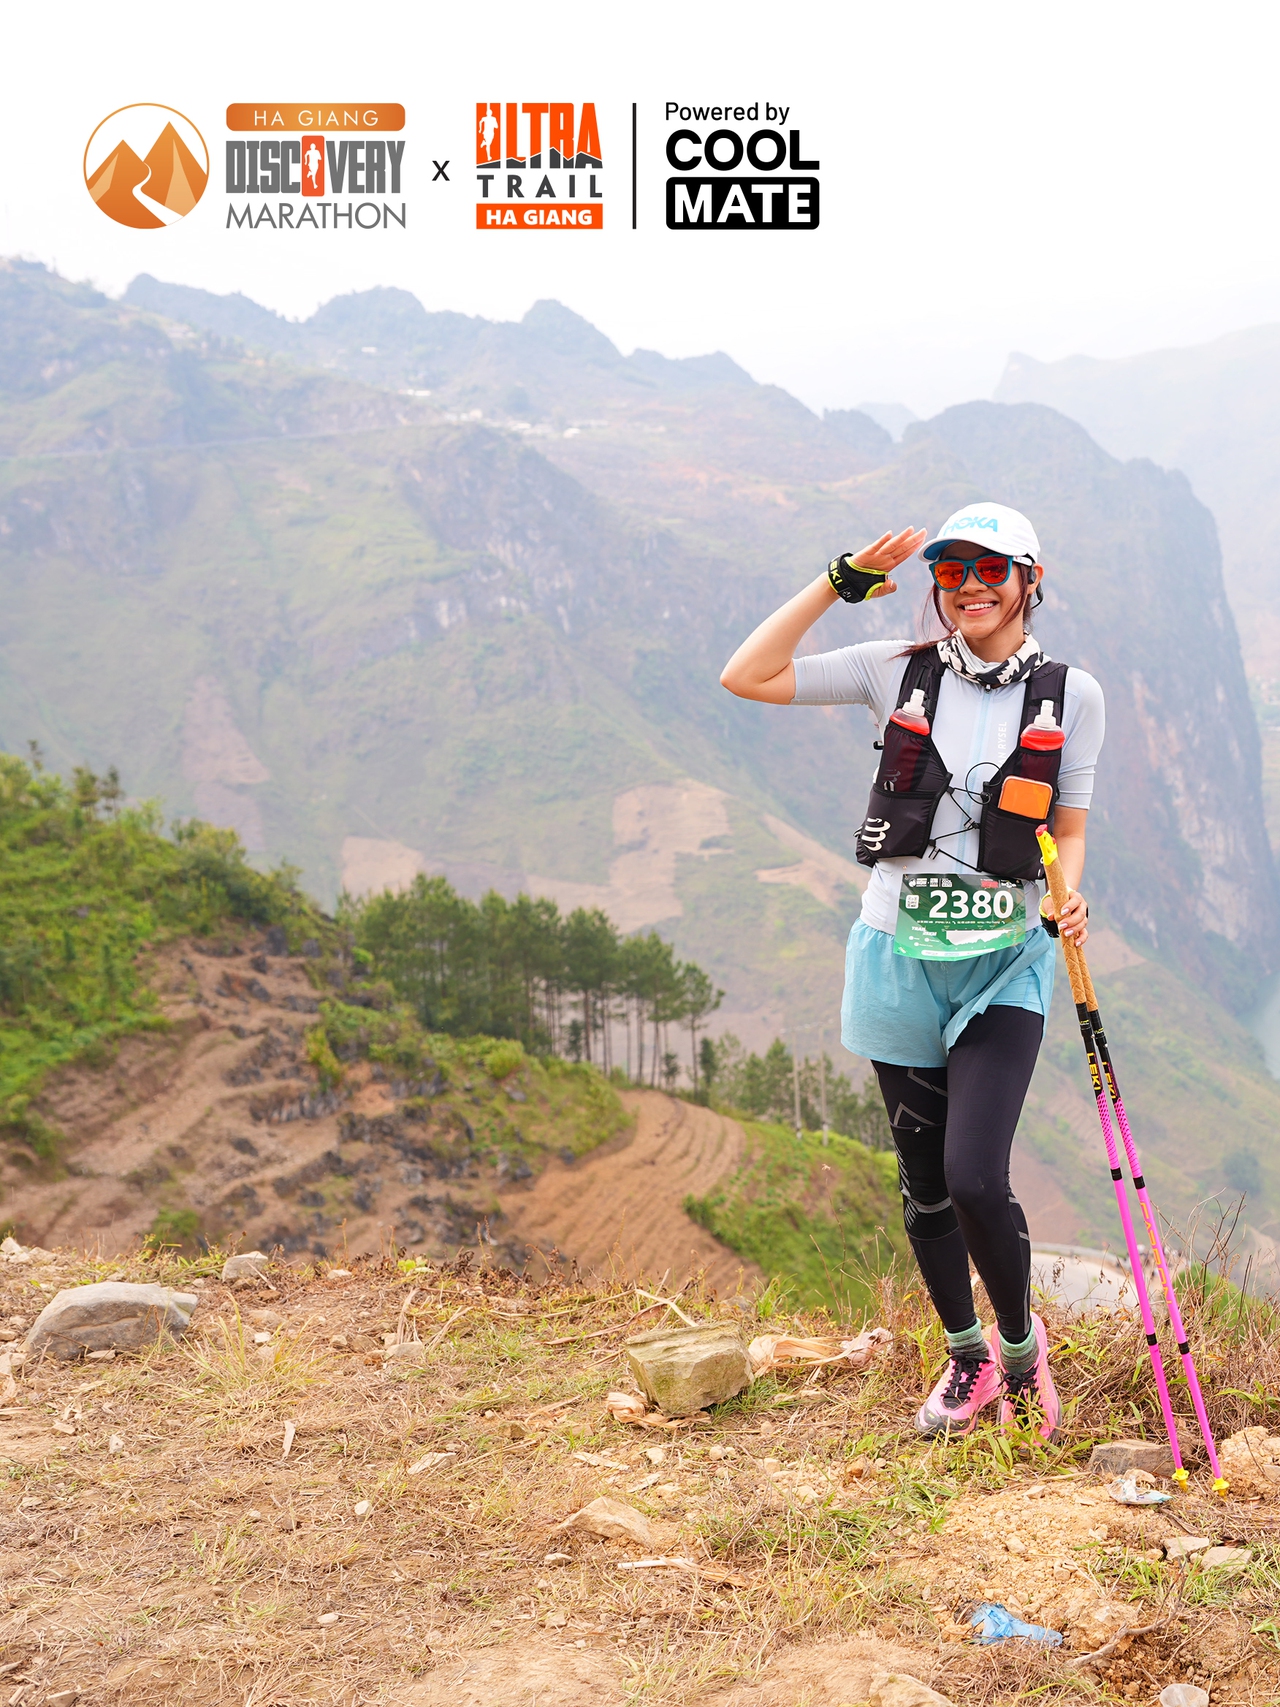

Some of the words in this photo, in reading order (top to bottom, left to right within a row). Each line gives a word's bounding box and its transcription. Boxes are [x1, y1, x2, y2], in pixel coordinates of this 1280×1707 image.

[943, 516, 998, 536] HOKA
[830, 560, 843, 585] EKI
[929, 890, 1014, 918] 2380
[1087, 1052, 1101, 1090] LEKI
